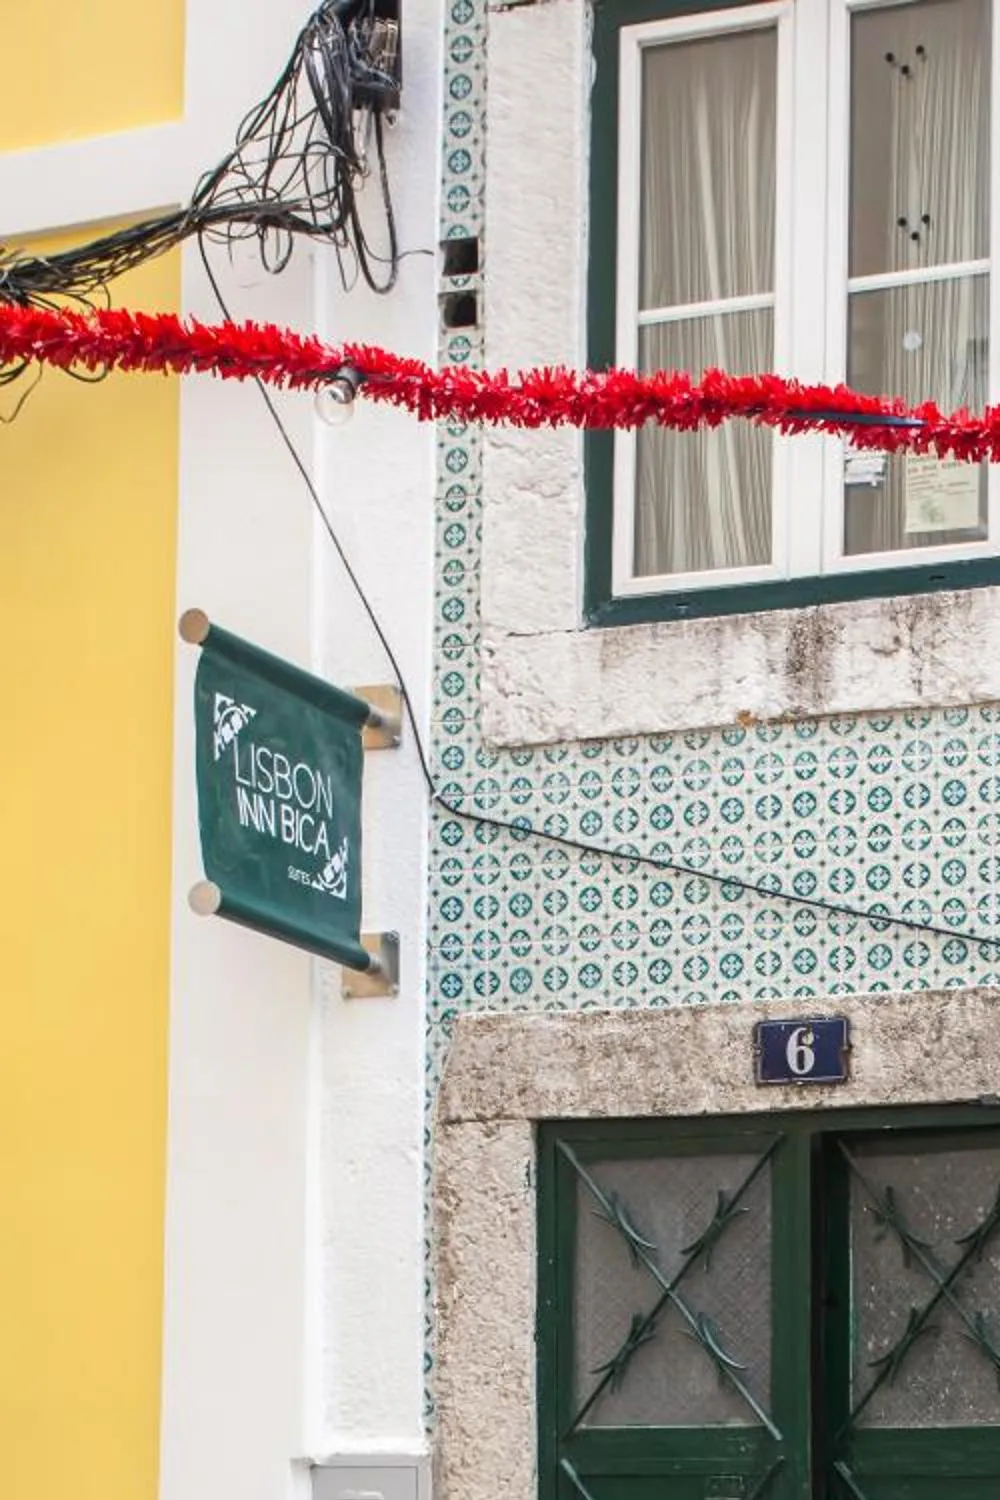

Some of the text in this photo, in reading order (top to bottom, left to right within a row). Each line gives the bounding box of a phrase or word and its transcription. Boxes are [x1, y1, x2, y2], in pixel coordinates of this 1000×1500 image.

[234, 736, 333, 820] LISBON
[236, 785, 332, 862] INN BICA
[786, 1026, 815, 1075] 6
